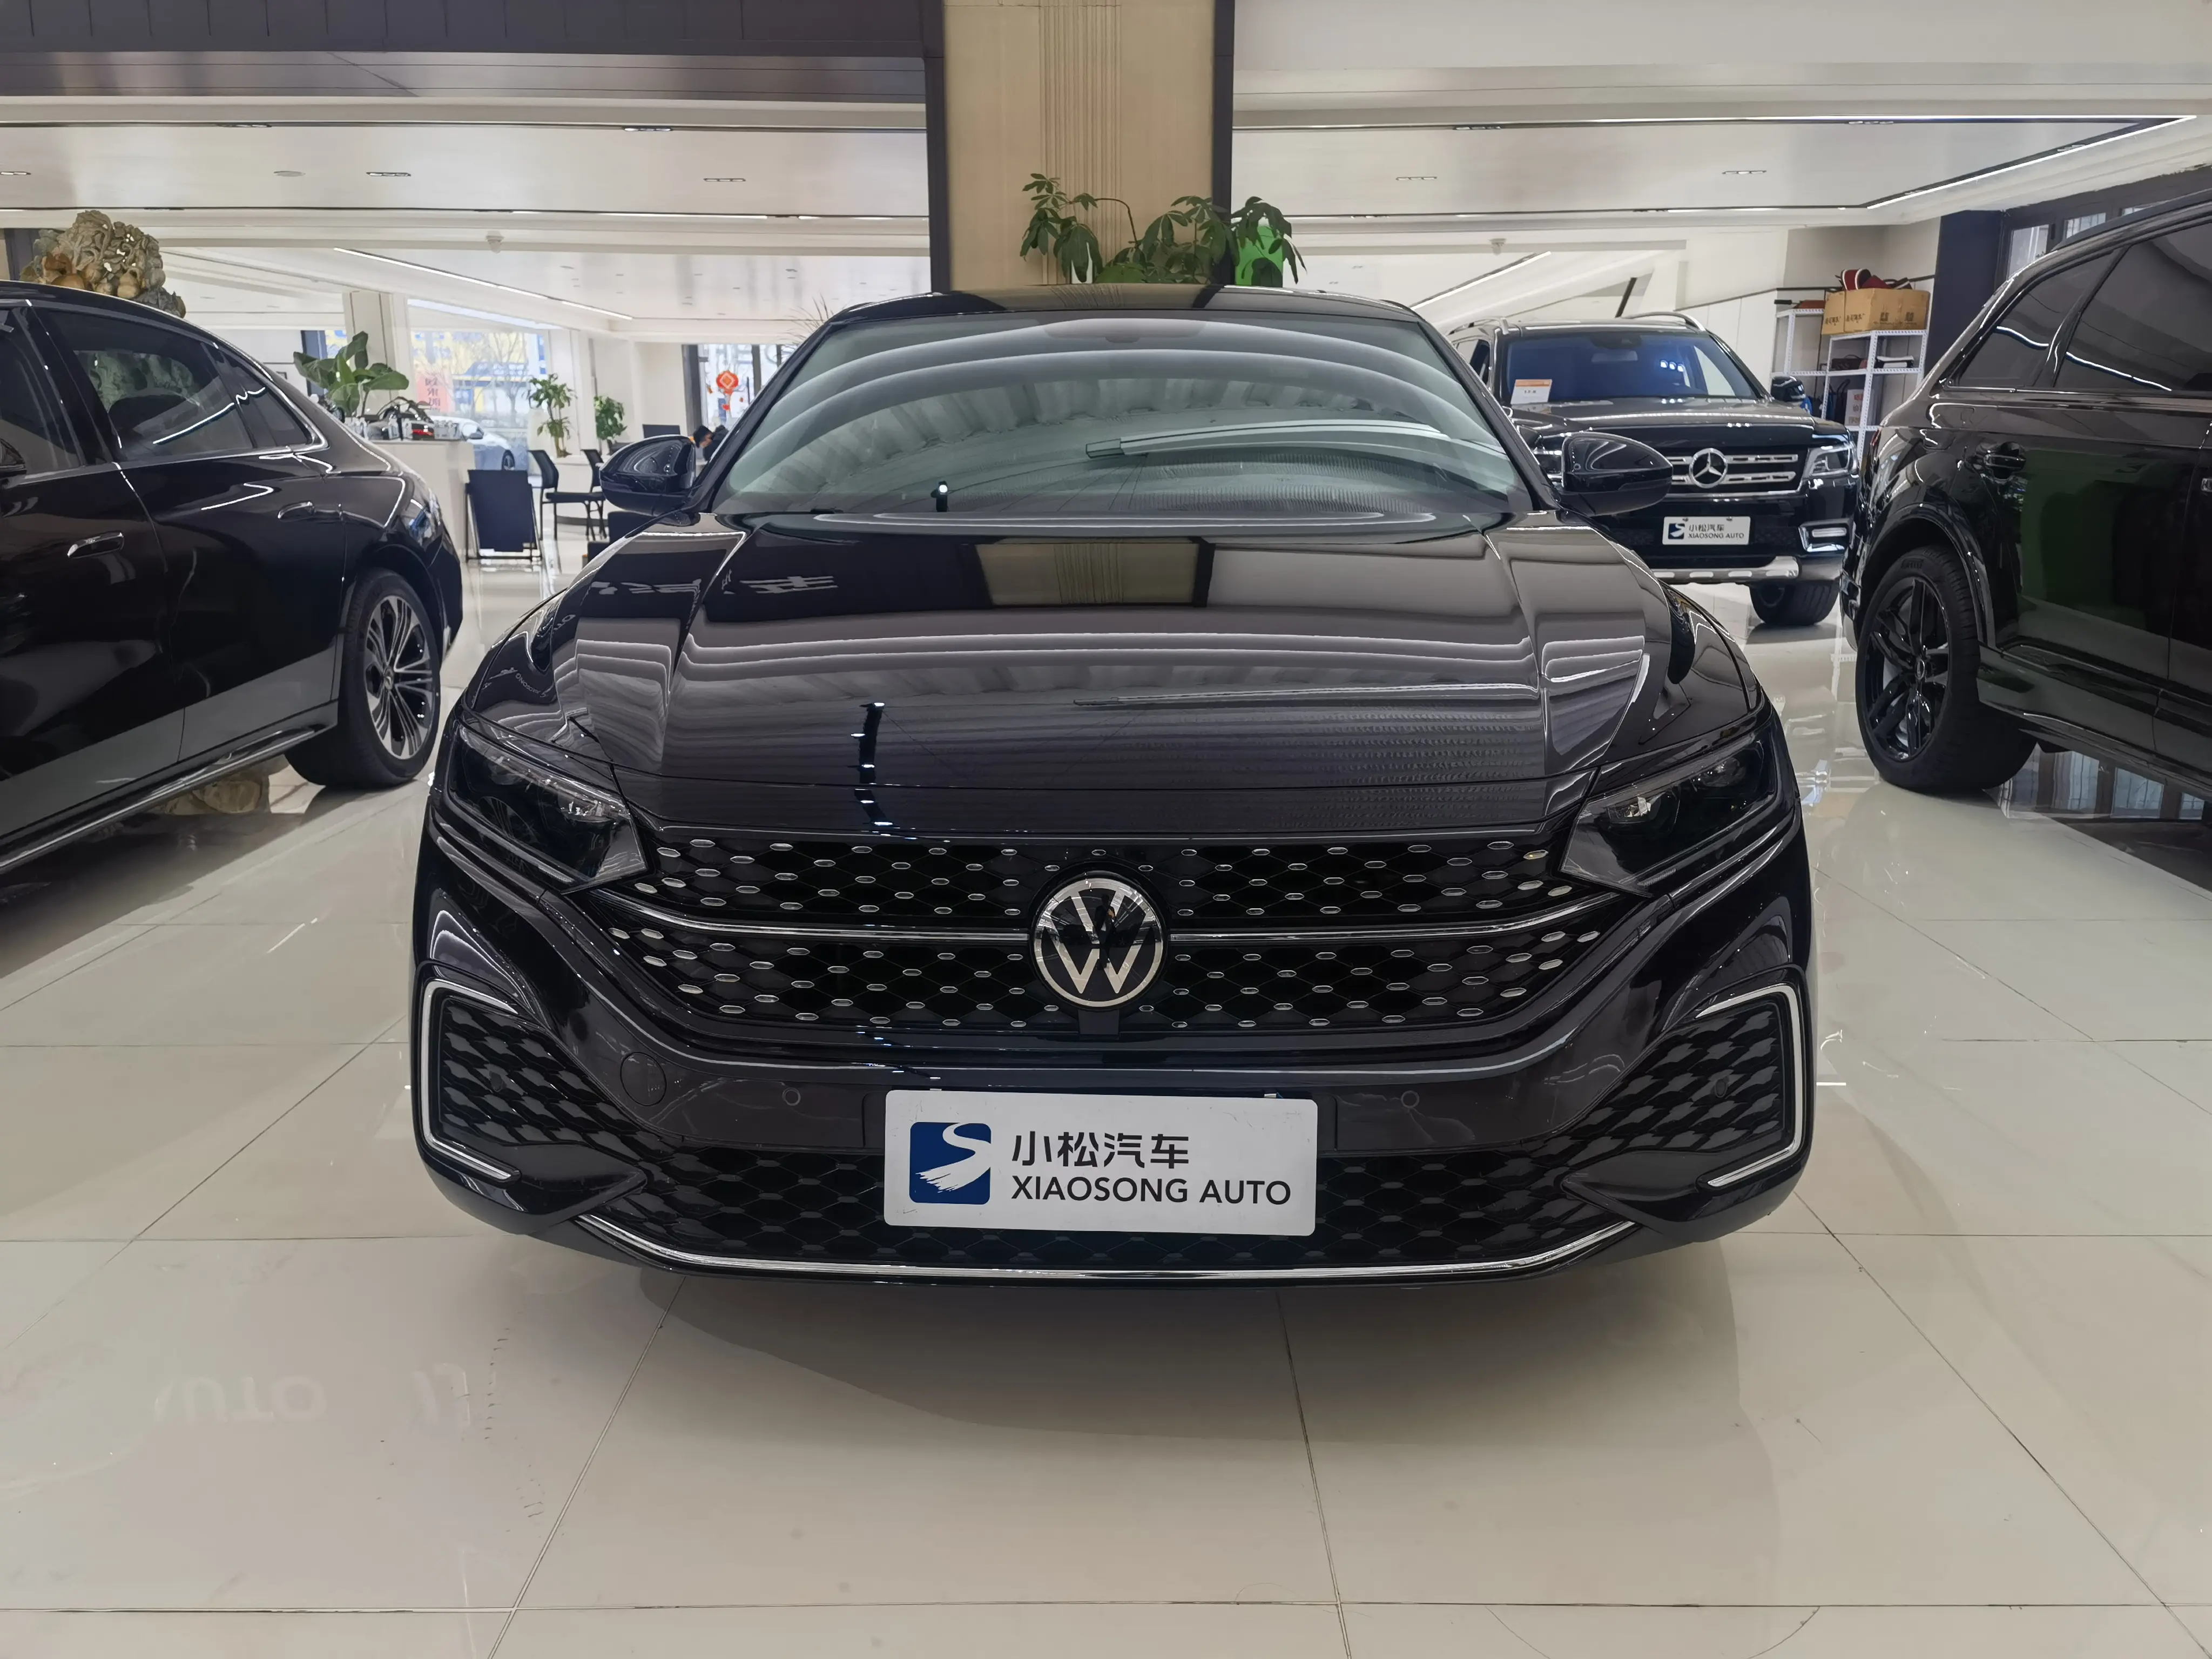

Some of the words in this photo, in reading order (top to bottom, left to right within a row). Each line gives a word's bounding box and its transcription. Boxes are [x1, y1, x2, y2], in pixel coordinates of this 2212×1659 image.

[1689, 524, 1724, 532] 小松汽车
[1011, 1131, 1189, 1170] 小松汽车
[1011, 1176, 1188, 1203] XIAOSONG
[1199, 1179, 1291, 1205] AUTO
